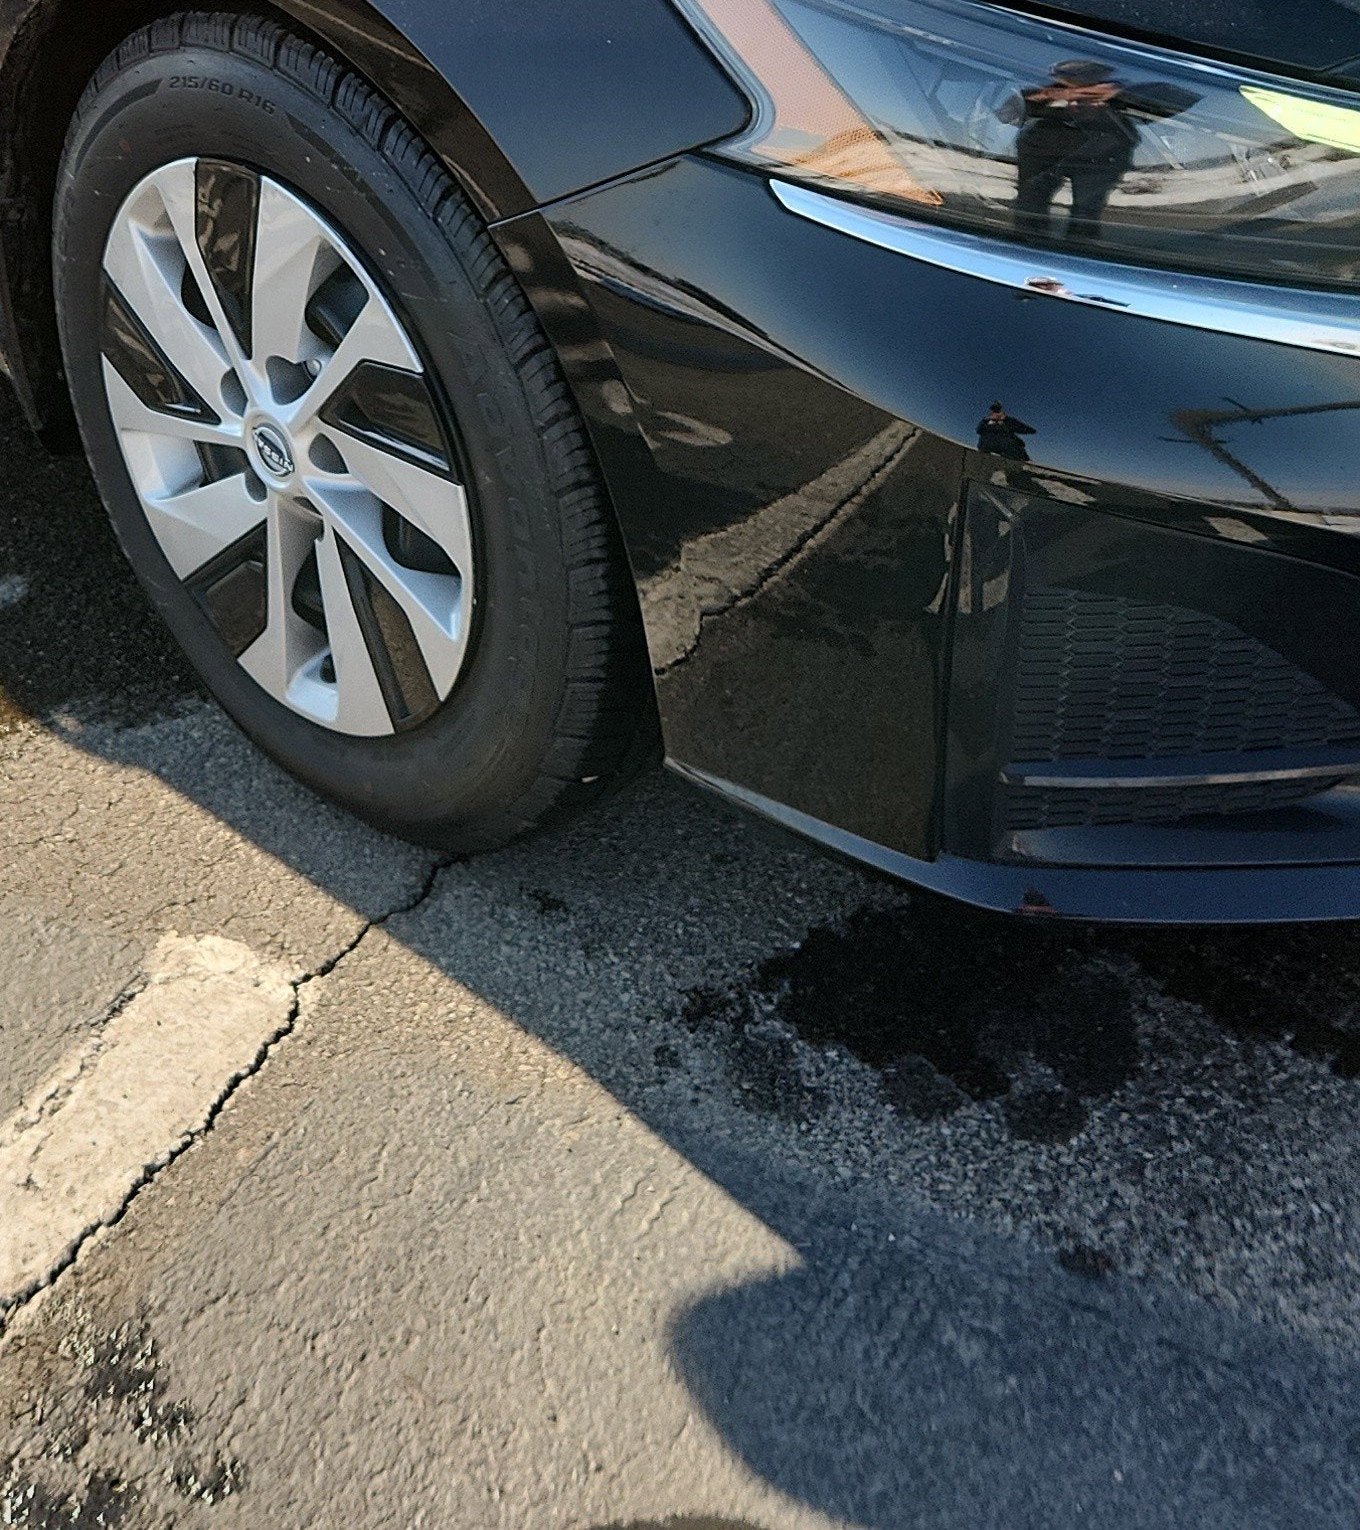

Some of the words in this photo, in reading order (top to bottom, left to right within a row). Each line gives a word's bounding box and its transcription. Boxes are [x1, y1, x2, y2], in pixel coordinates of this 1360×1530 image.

[168, 75, 235, 96] 215/60
[238, 87, 277, 115] R16
[253, 430, 294, 472] NISSAN
